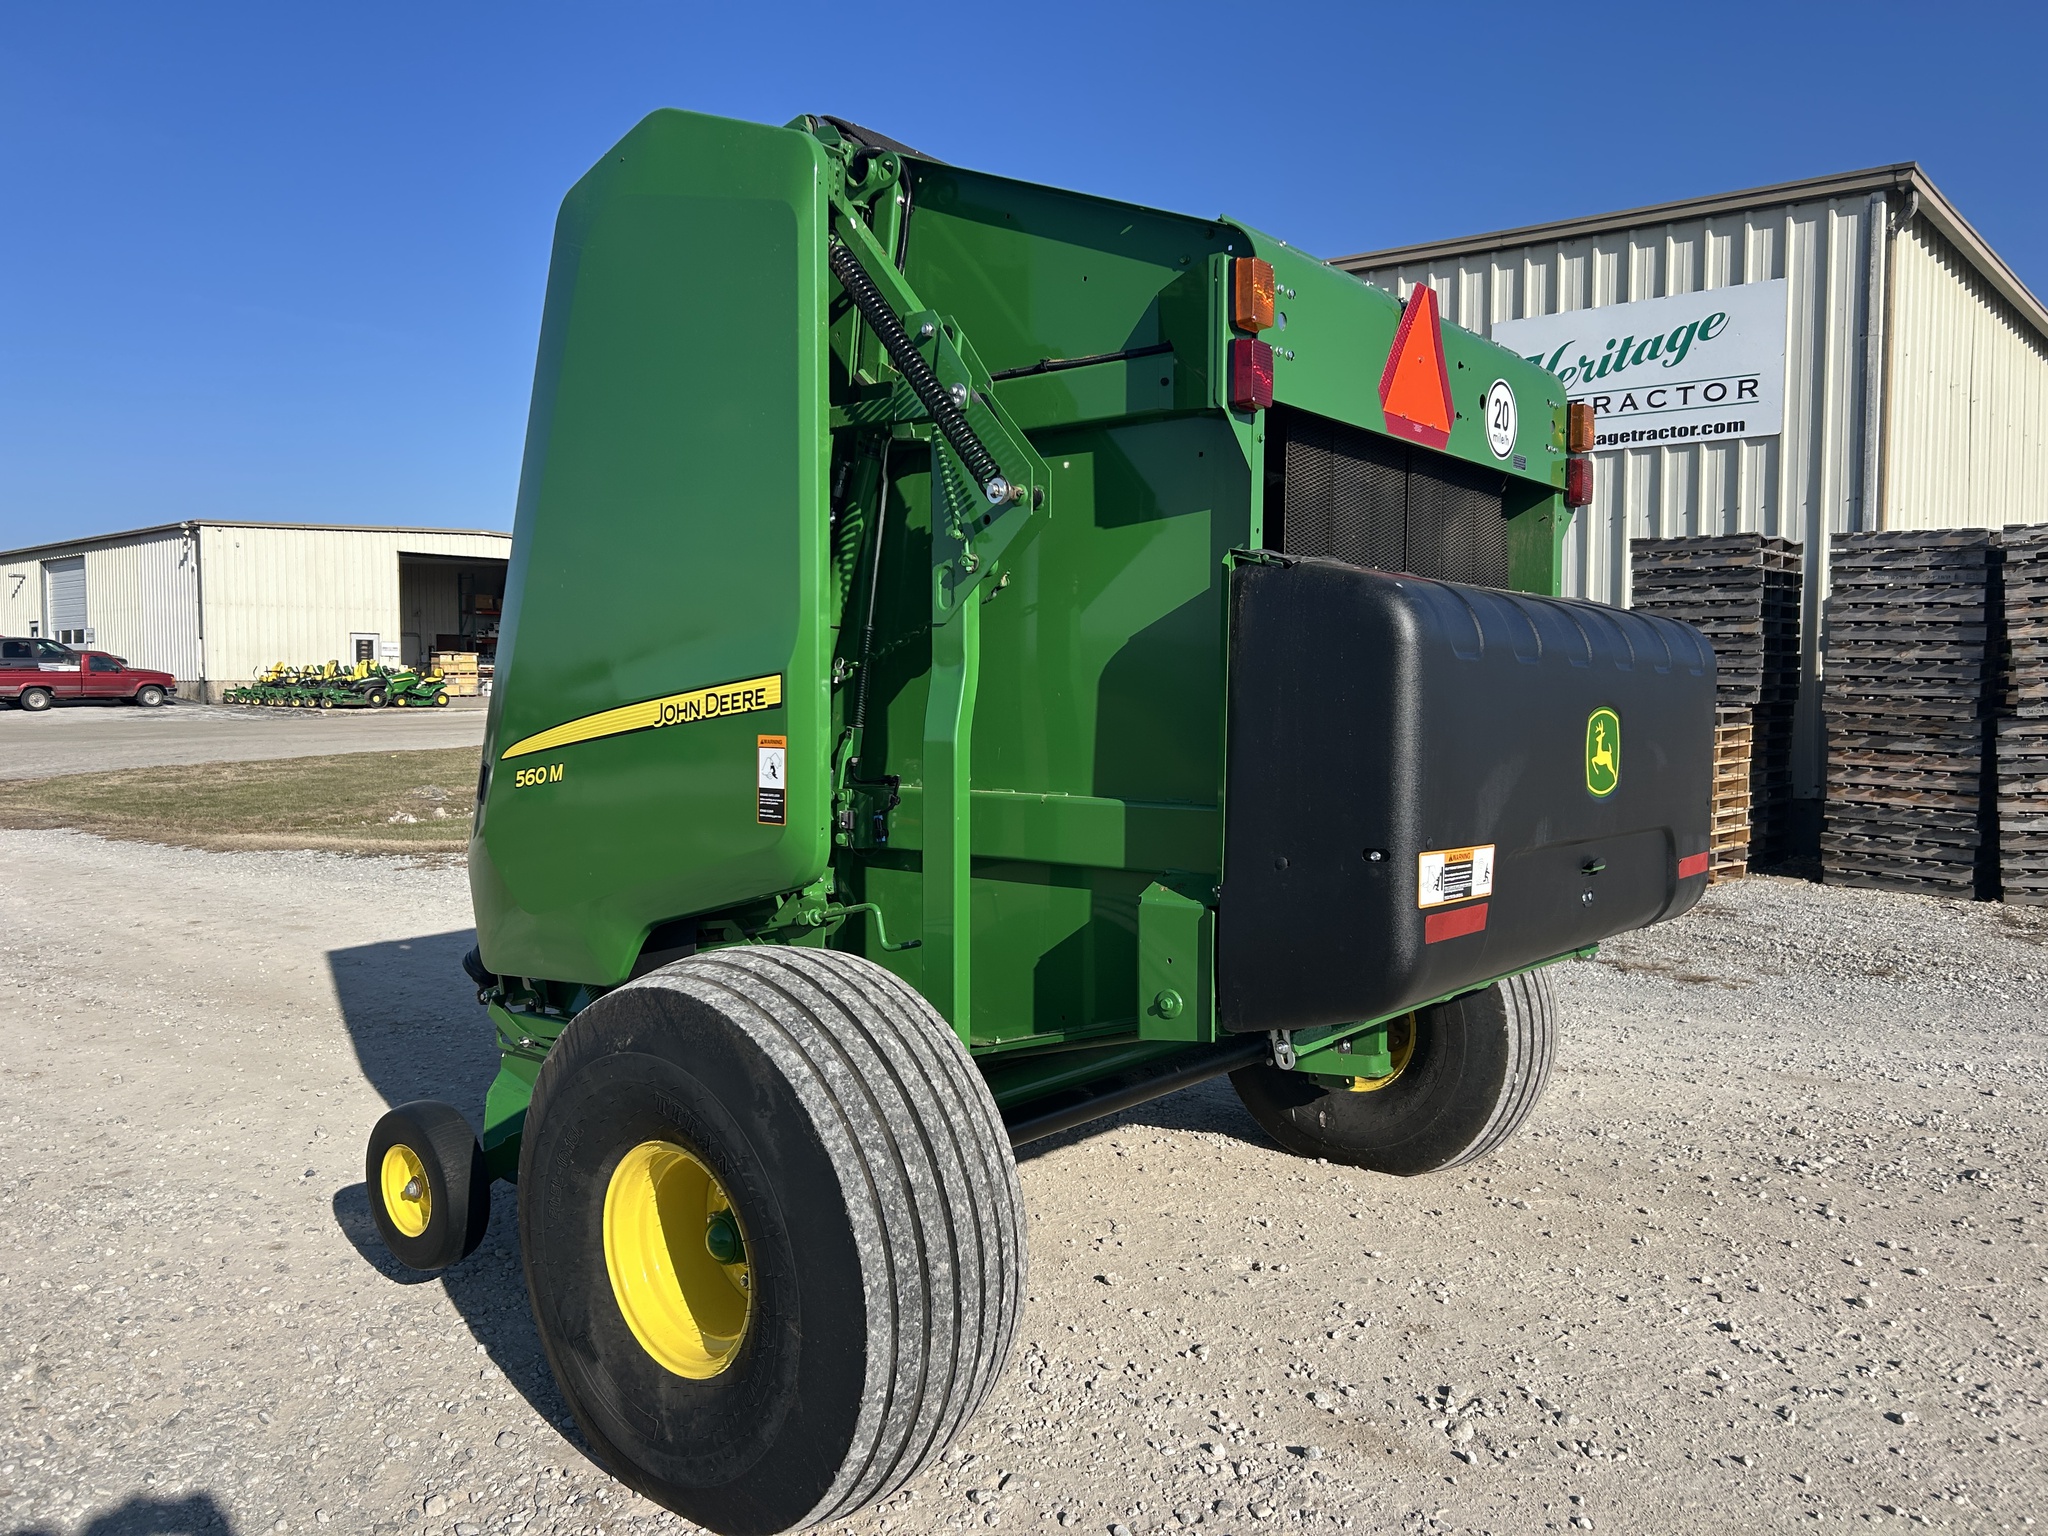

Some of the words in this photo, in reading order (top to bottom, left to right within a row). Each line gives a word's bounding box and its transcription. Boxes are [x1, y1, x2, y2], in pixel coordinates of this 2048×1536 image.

[1494, 398, 1509, 432] 20
[1593, 420, 1745, 446] agetractor.com
[654, 700, 700, 725] JOHN
[705, 688, 766, 716] DEERE
[515, 766, 548, 788] 560
[549, 763, 564, 782] M
[1453, 853, 1470, 861] WARNING
[654, 1090, 736, 1178] TITAN
